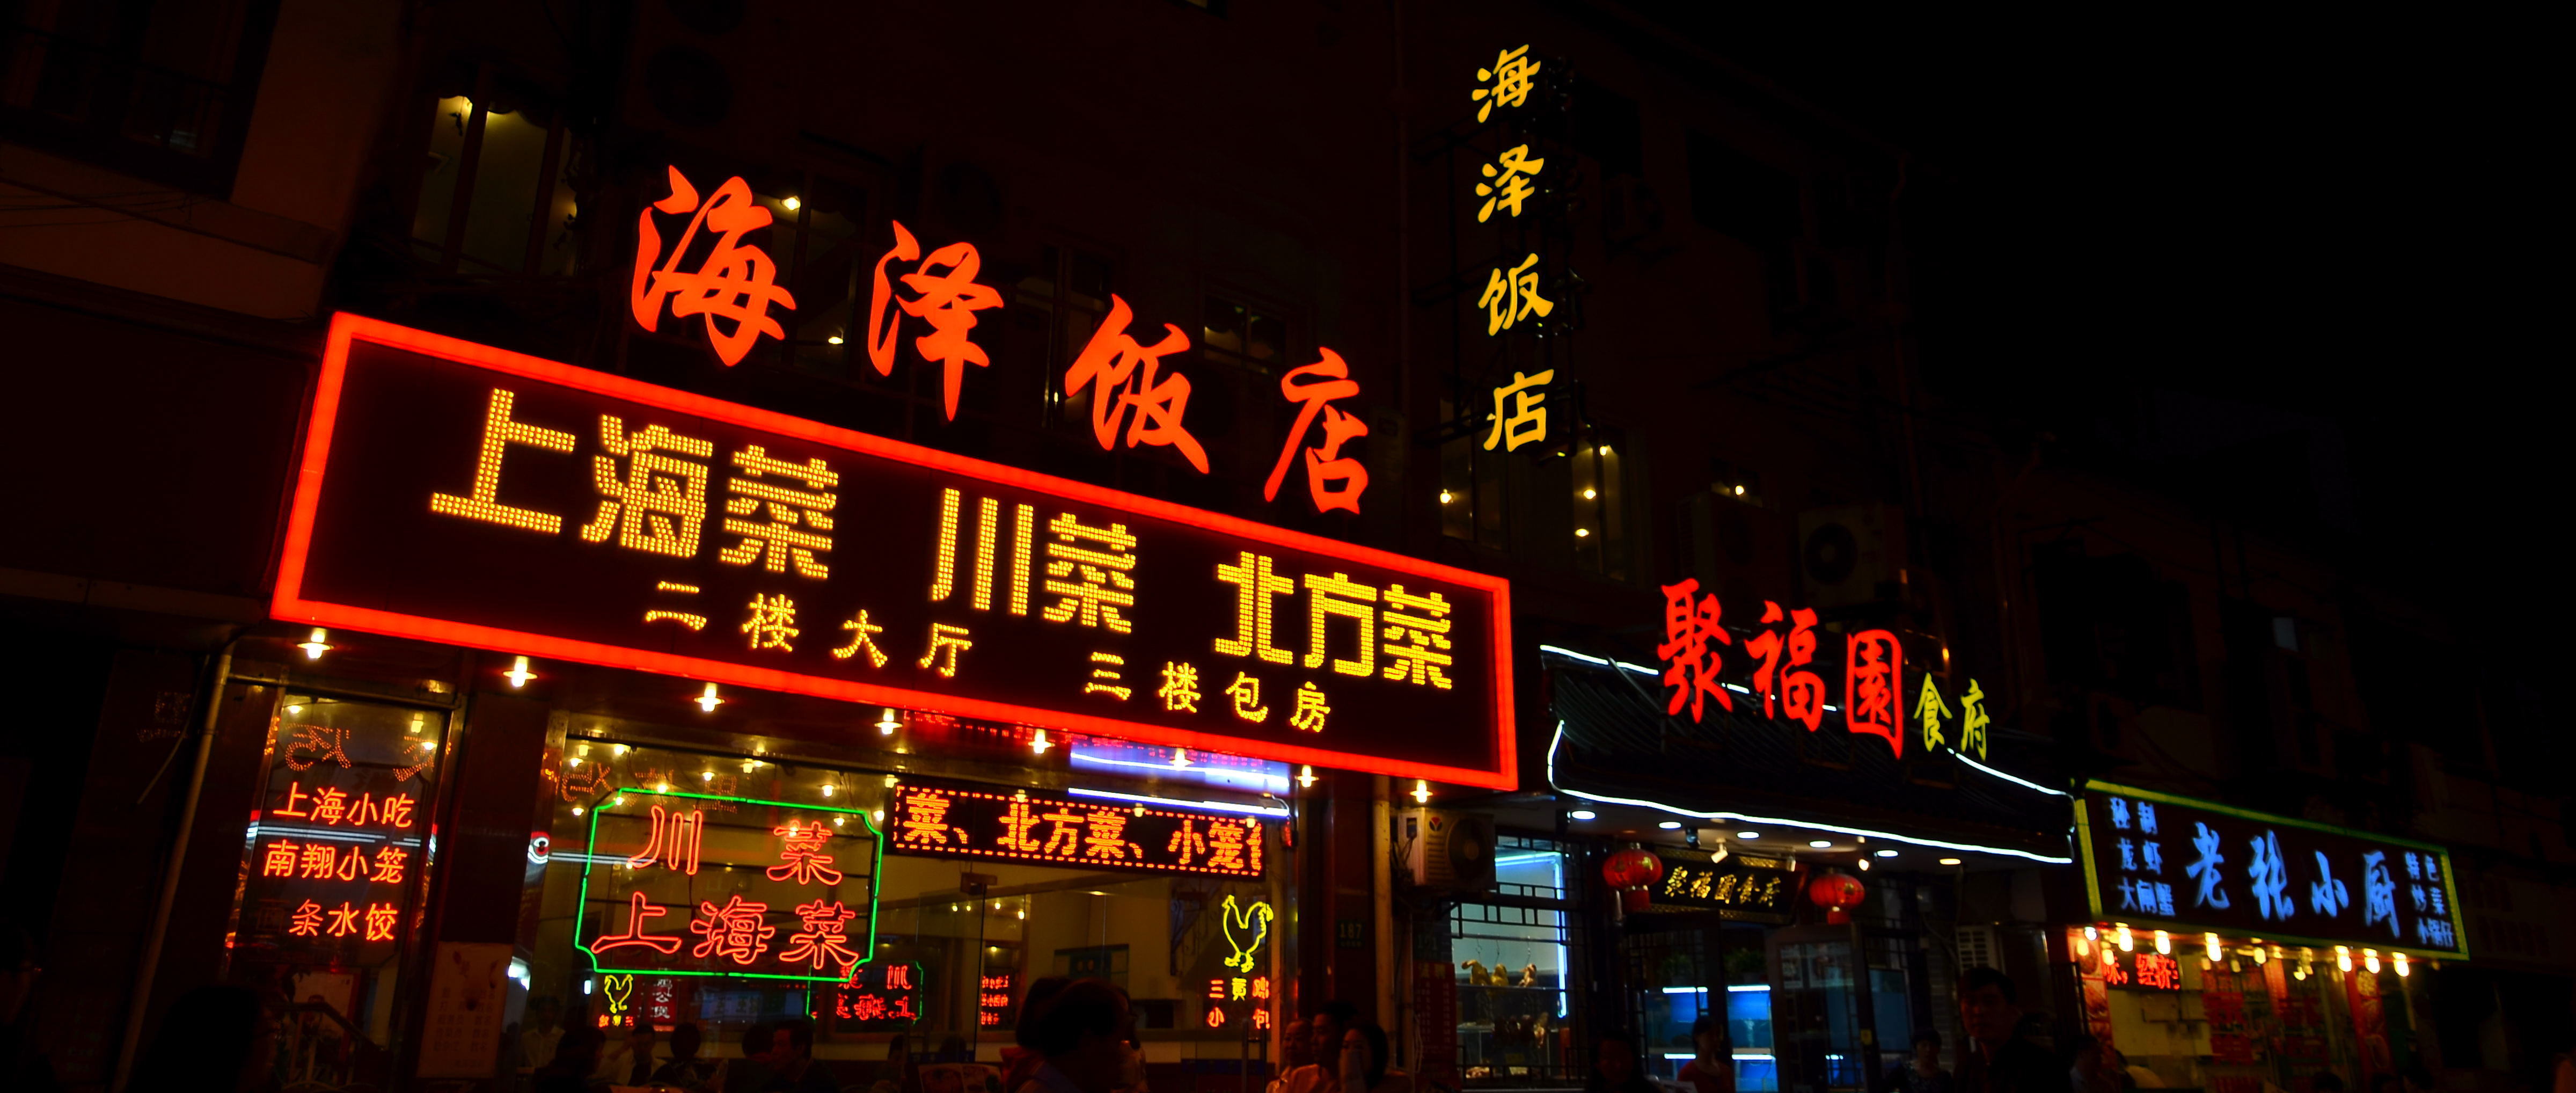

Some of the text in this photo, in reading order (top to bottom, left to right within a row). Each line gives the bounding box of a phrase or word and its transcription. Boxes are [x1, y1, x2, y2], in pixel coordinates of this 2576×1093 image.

[1472, 44, 1554, 453] 海泽饭店
[631, 164, 1369, 515] 海泽饭店
[430, 388, 1453, 690] 上海菜 川菜 北方菜
[645, 579, 1332, 734] 二楼大厅 三楼包房
[1914, 672, 1990, 761] 食府
[272, 781, 415, 829] 上海小吃
[627, 805, 843, 886] 川菜
[262, 839, 409, 885] 南翔小笼
[288, 899, 399, 942] 条水饺
[590, 891, 860, 971] 上海菜
[1339, 922, 1363, 940] 187
